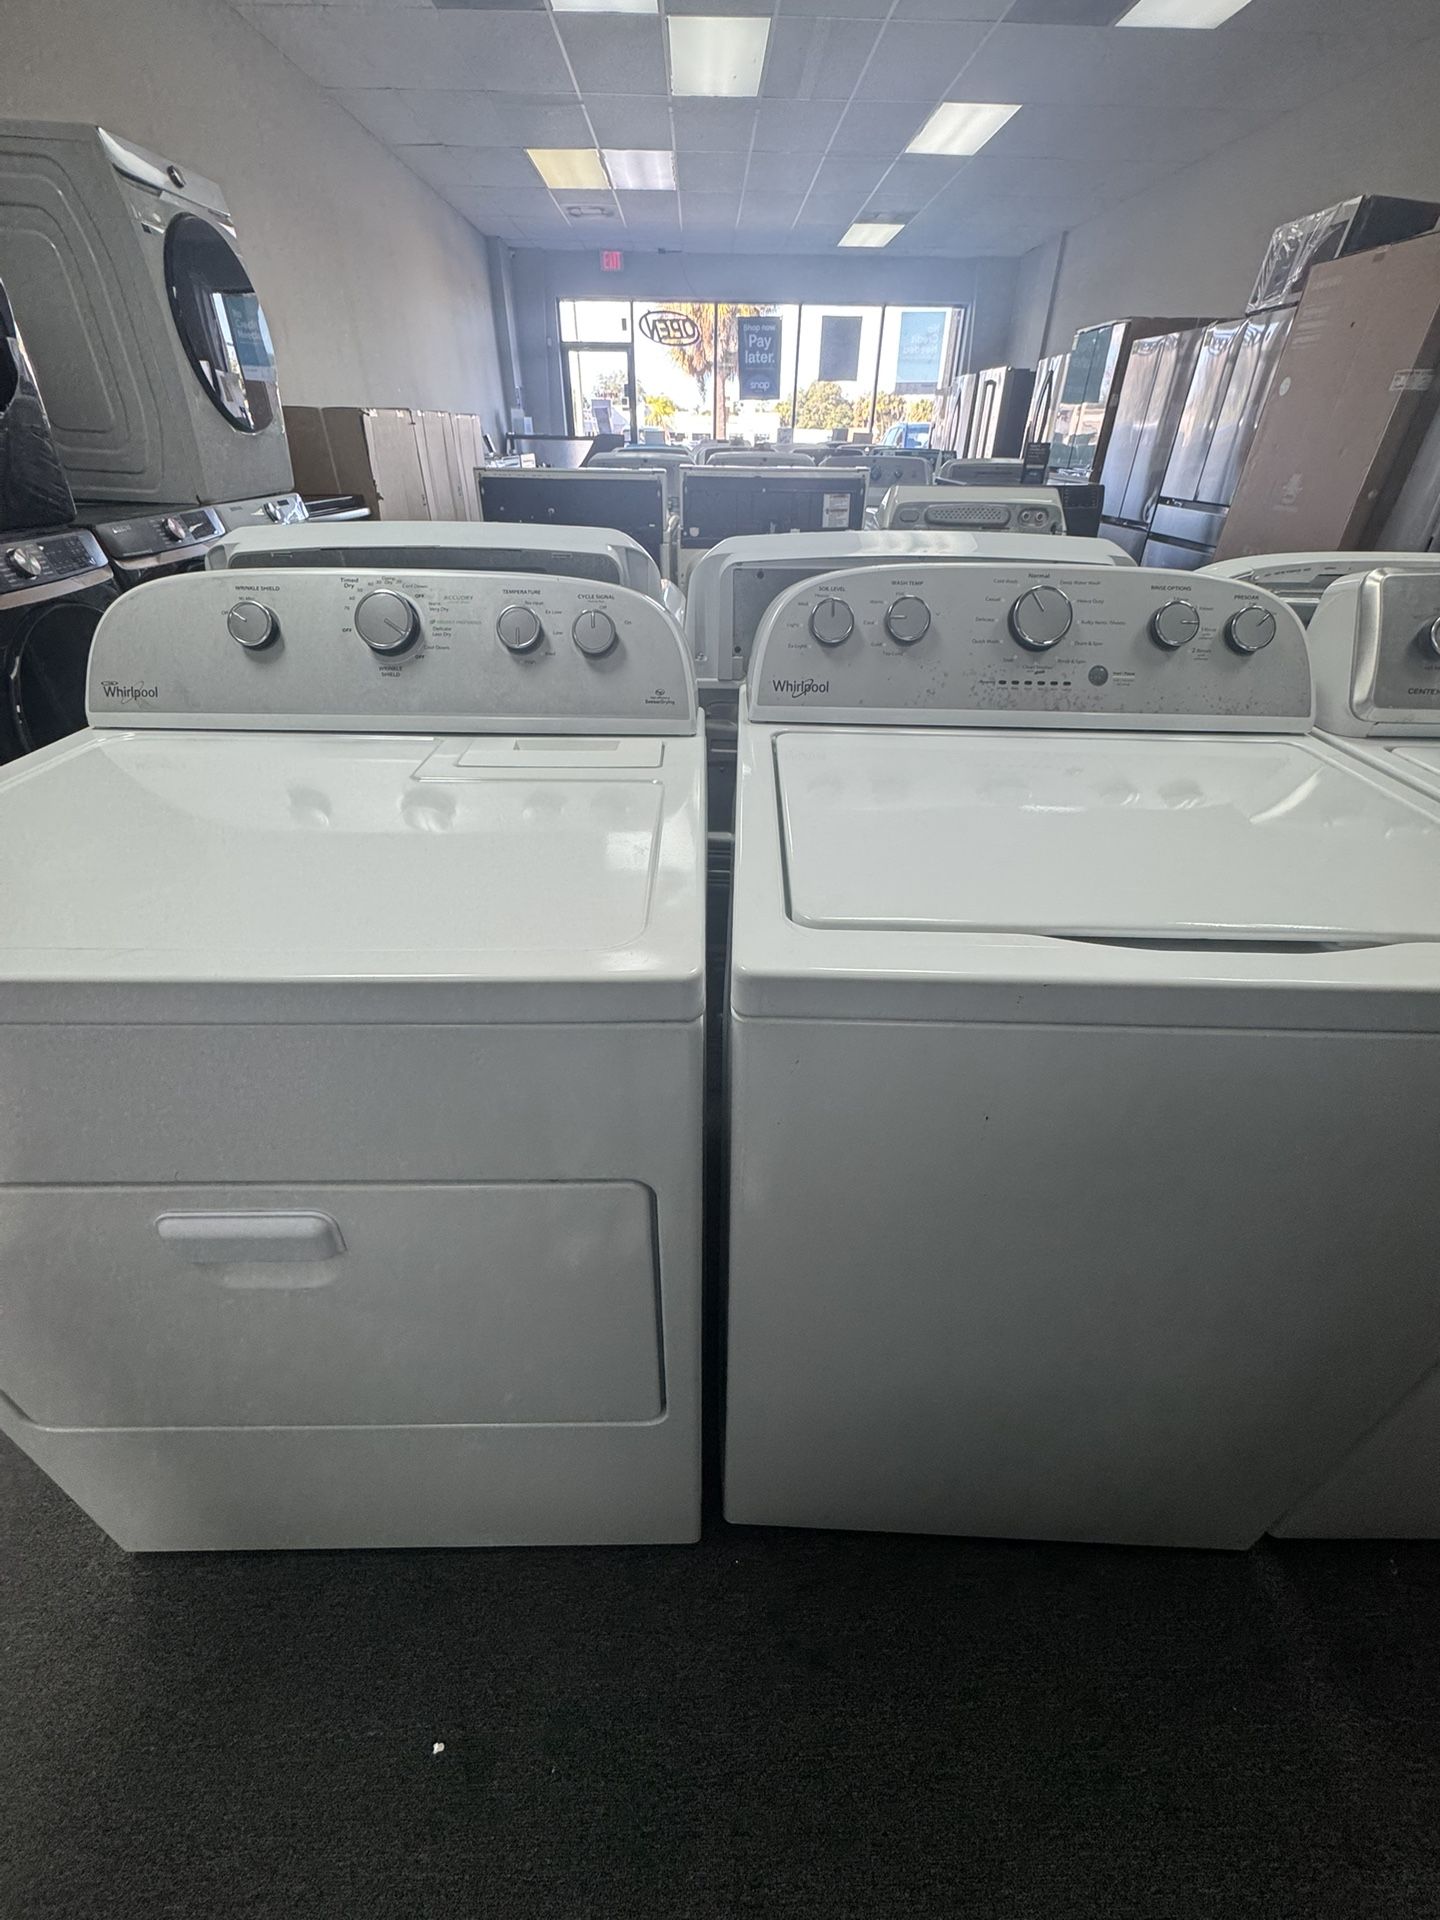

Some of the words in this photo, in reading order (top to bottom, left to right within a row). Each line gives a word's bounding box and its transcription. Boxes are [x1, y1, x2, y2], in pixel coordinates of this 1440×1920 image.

[603, 251, 621, 270] EXIT
[743, 324, 760, 333] Shop
[748, 334, 772, 350] Pay
[744, 350, 775, 364] later.
[750, 381, 770, 392] snap
[103, 683, 158, 703] Whirlpool
[772, 679, 829, 698] Whirlpool
